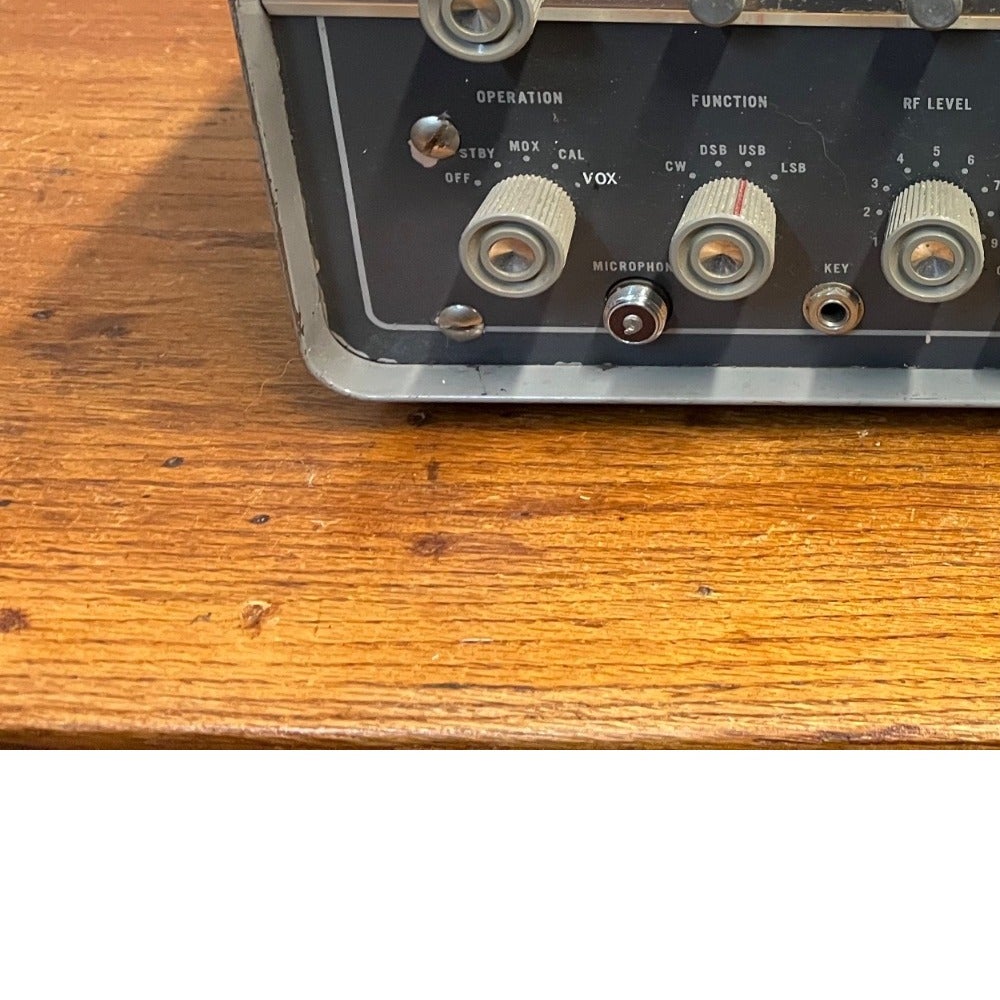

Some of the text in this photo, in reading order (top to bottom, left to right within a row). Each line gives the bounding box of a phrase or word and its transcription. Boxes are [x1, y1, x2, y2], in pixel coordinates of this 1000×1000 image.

[476, 90, 563, 105] OPERATION
[691, 93, 768, 109] FUNCTION
[903, 97, 972, 111] RF LEVEL
[509, 140, 540, 152] MOX
[700, 144, 728, 156] DSB
[738, 144, 767, 156] USB
[933, 146, 941, 157] 5
[459, 147, 495, 159] STBY
[558, 149, 585, 161] CAL
[896, 153, 904, 164] 4
[967, 154, 975, 165] 6
[665, 161, 687, 172] CW
[781, 162, 807, 174] LSB
[445, 172, 470, 184] OFF
[582, 171, 618, 185] VOX
[871, 178, 879, 188] 3
[993, 179, 1000, 191] 7
[863, 207, 871, 217] 2
[872, 237, 878, 247] 1
[991, 238, 999, 249] 9
[592, 260, 673, 273] MICROPHON
[824, 262, 850, 274] KEY
